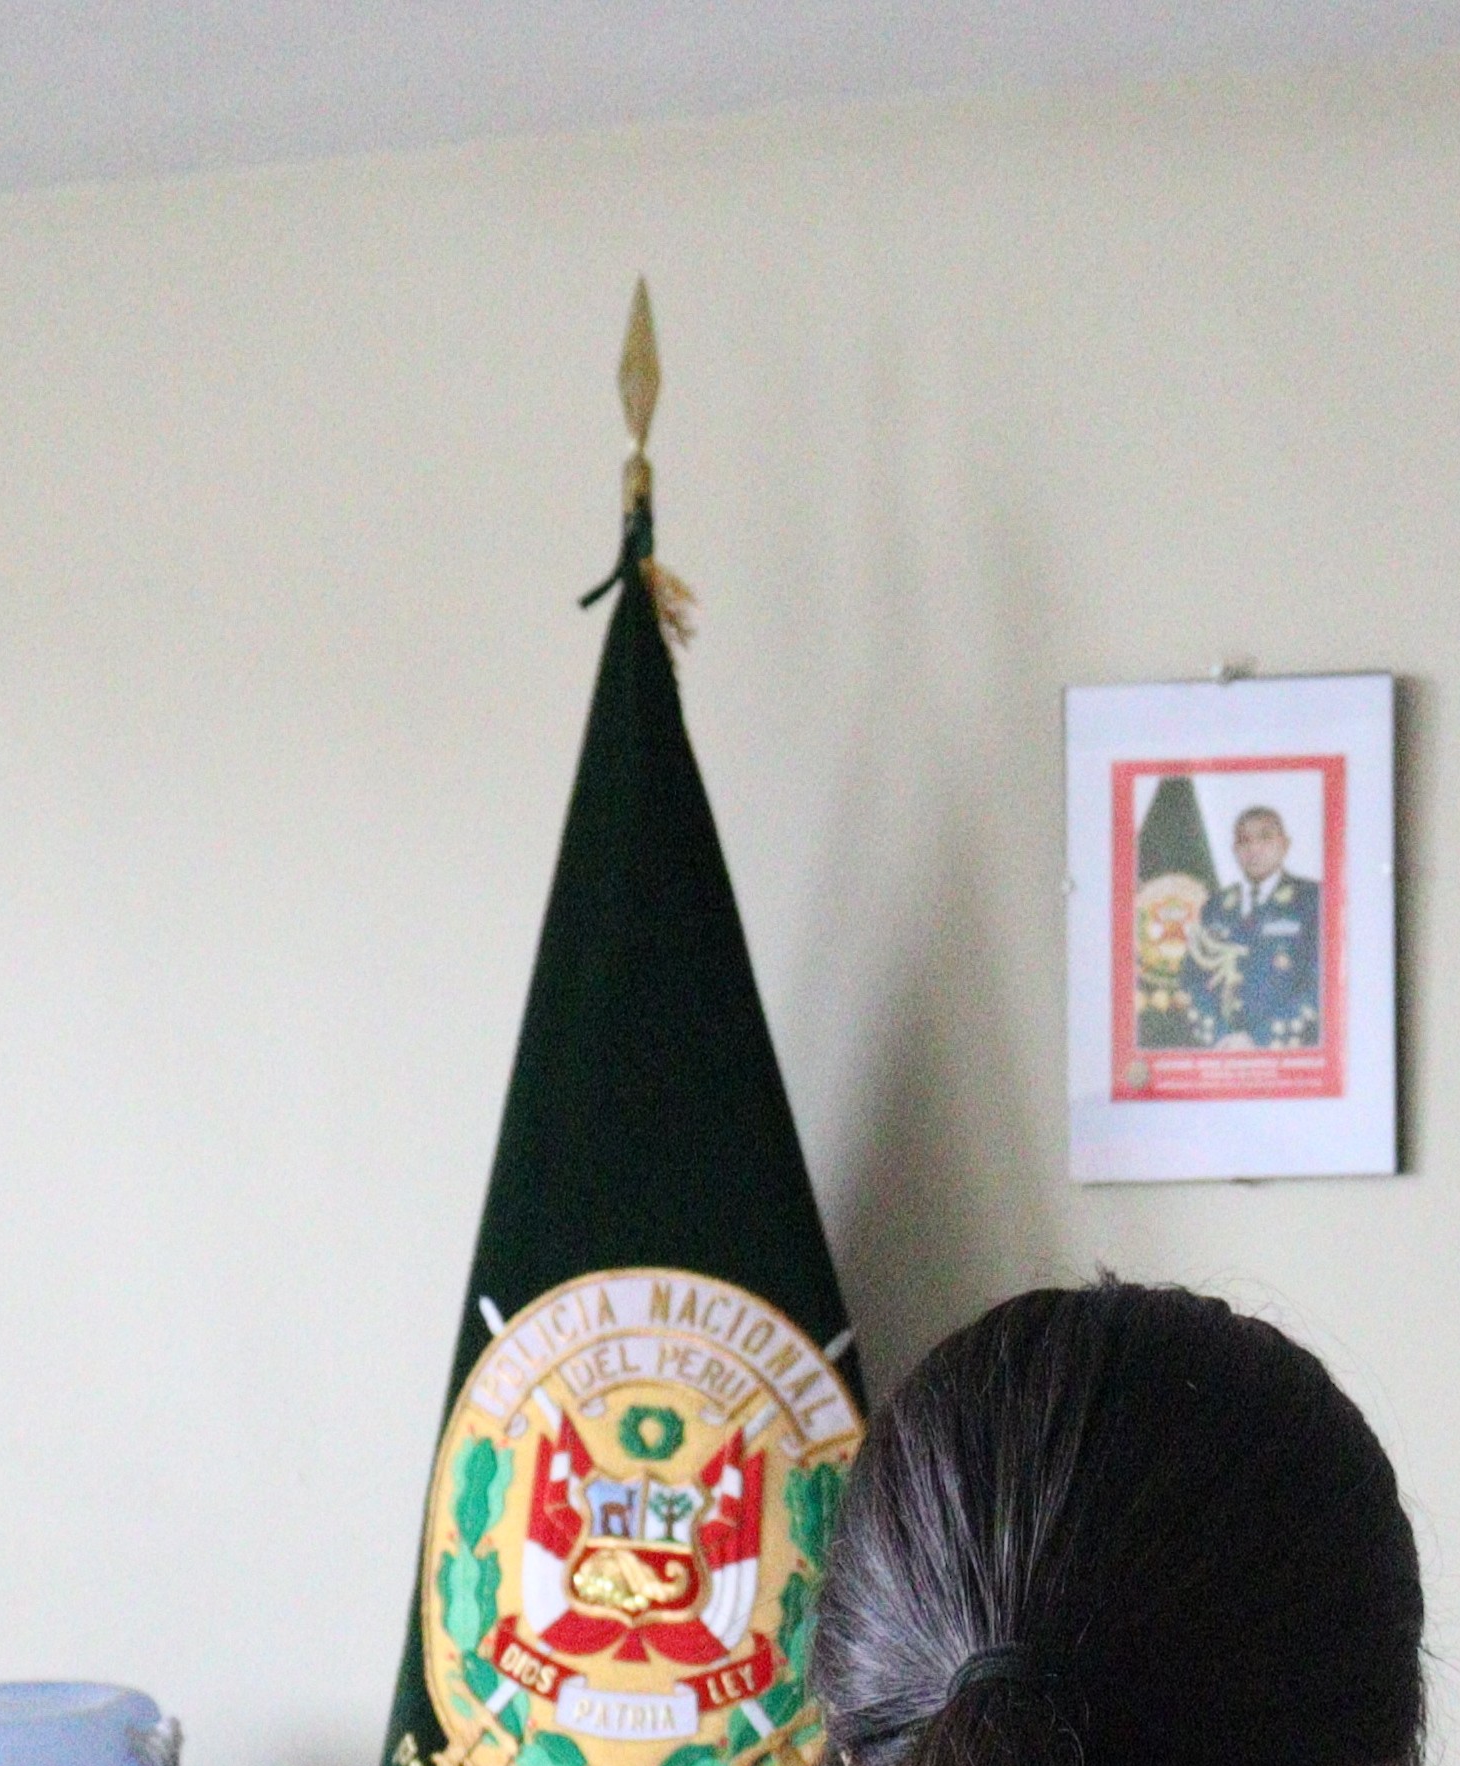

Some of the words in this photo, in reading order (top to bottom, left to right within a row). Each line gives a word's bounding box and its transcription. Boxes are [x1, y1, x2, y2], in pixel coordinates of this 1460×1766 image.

[476, 1287, 617, 1406] POLICIA
[649, 1279, 837, 1429] NACIONAL
[568, 1346, 639, 1390] DEL
[655, 1342, 753, 1401] PERU
[499, 1642, 558, 1694] DIOS
[705, 1664, 755, 1705] LEY
[575, 1699, 677, 1730] PATRIA
